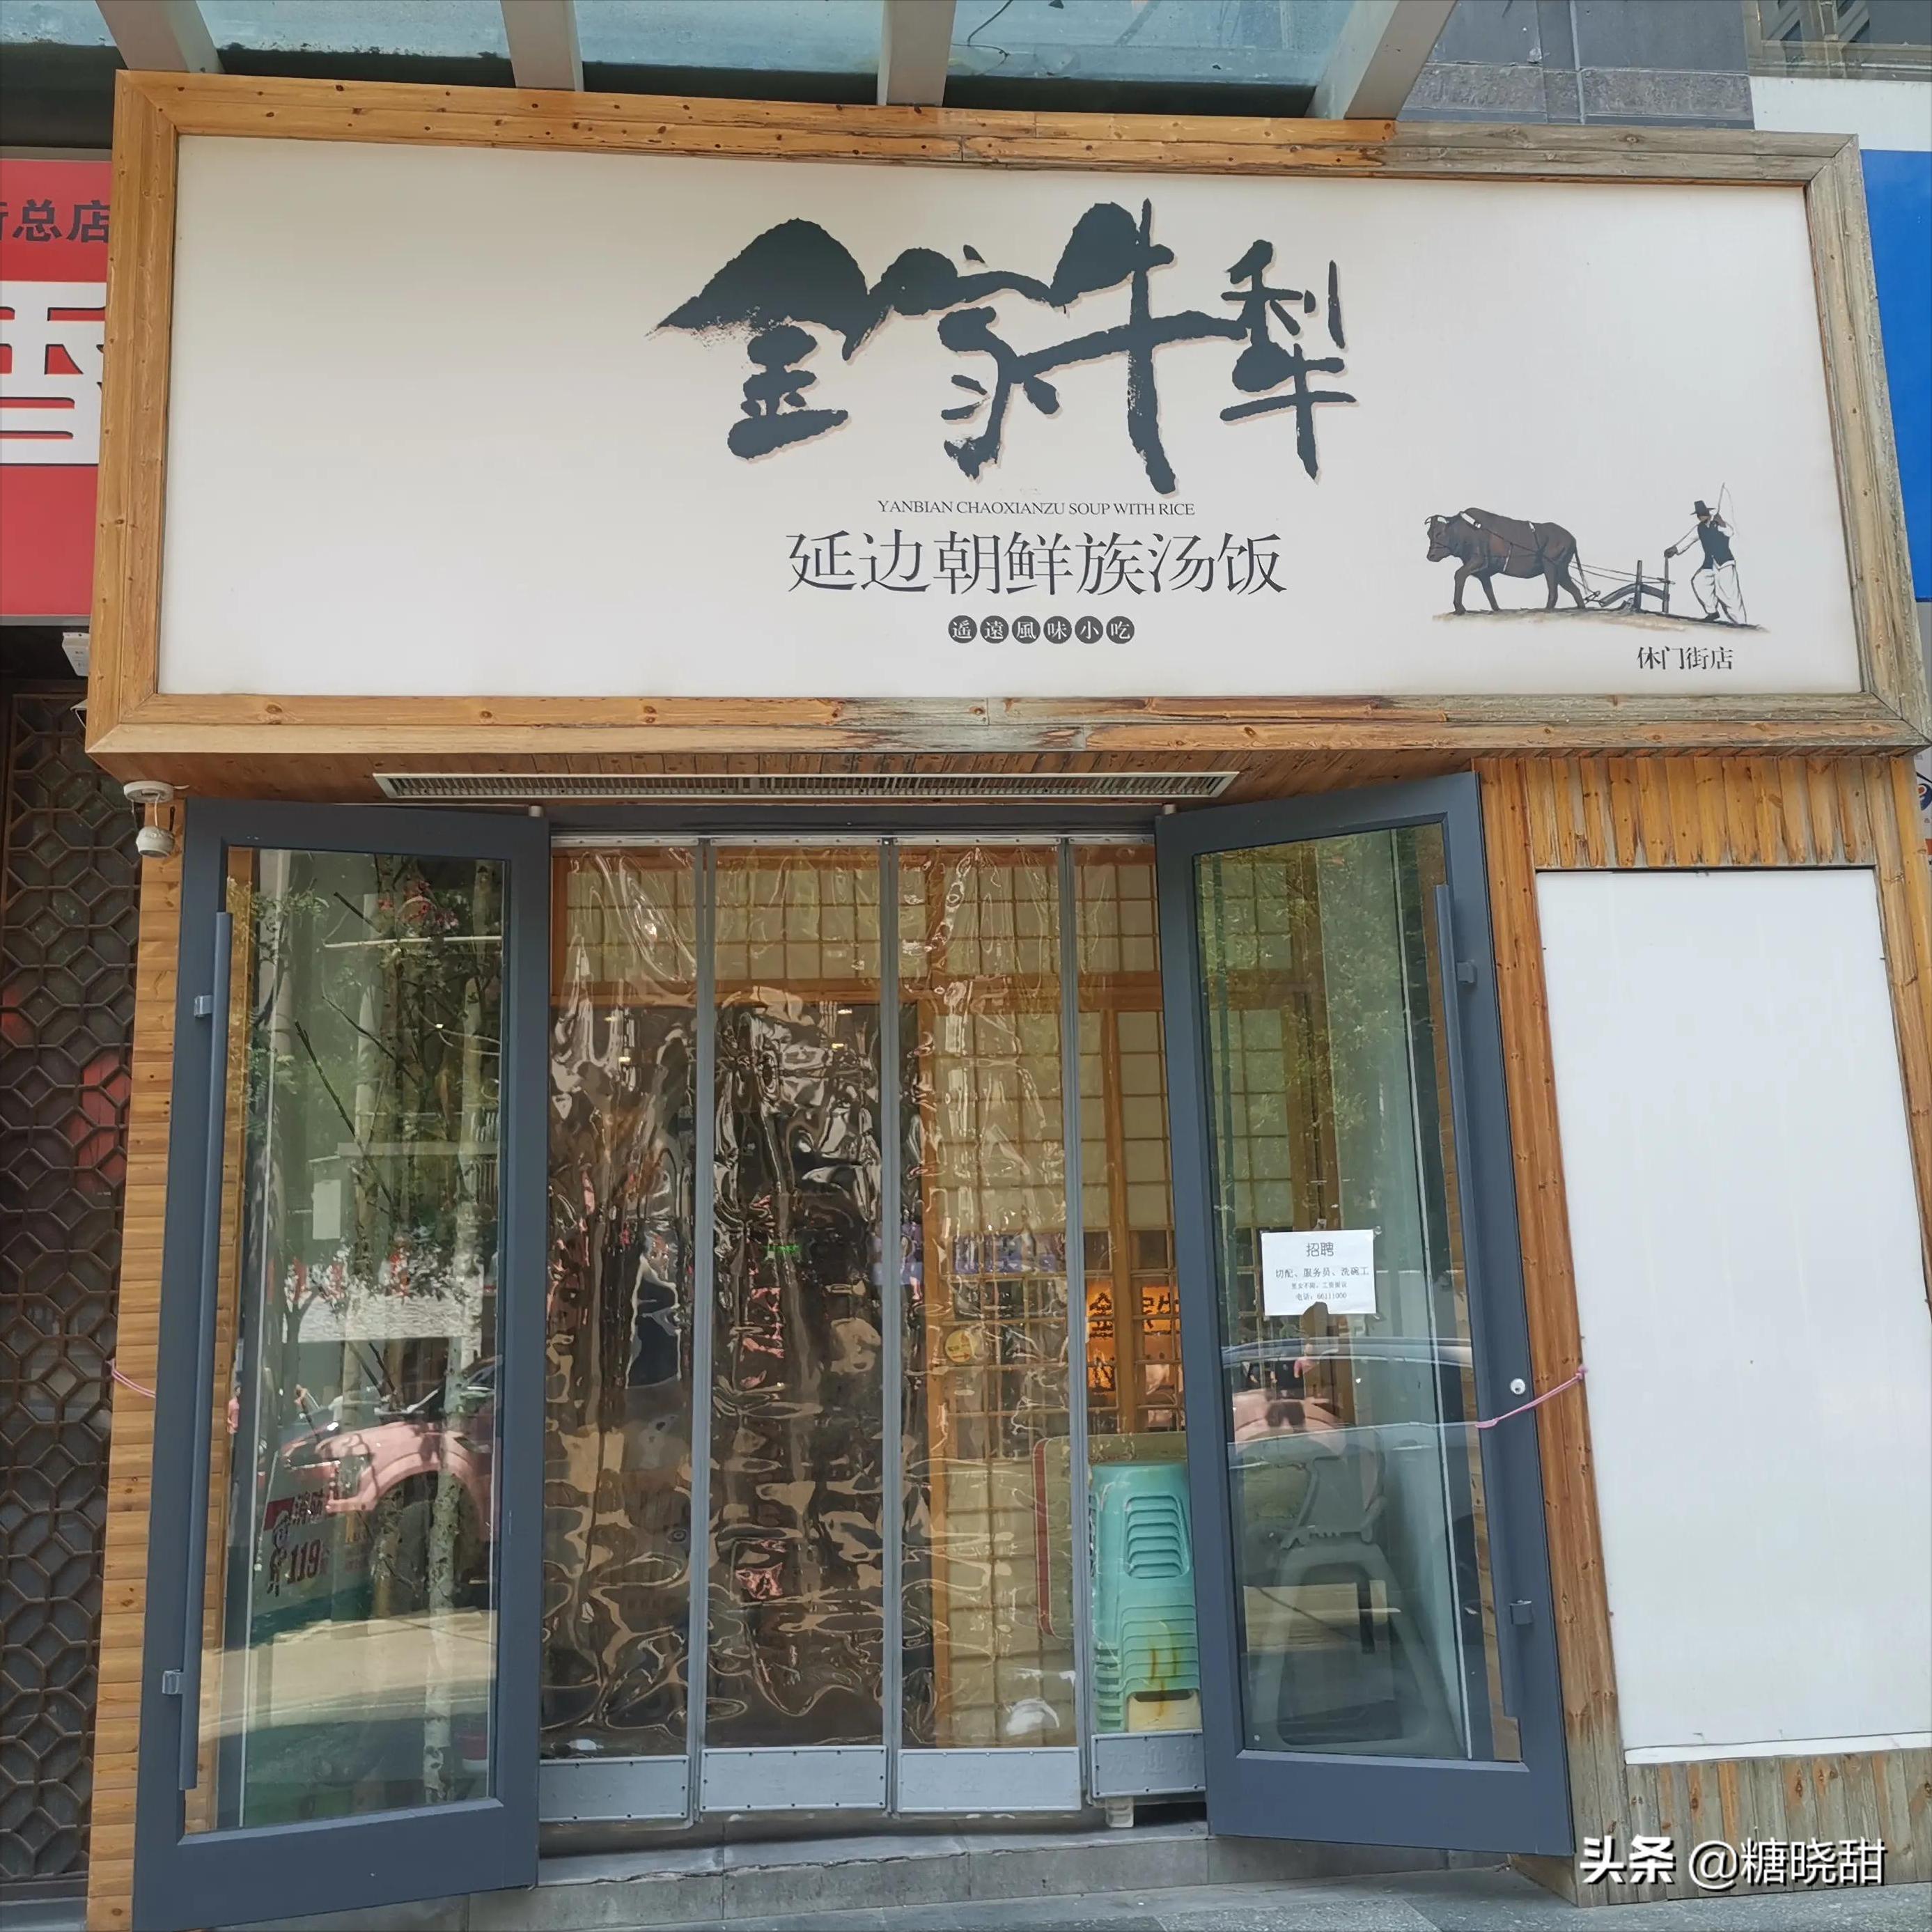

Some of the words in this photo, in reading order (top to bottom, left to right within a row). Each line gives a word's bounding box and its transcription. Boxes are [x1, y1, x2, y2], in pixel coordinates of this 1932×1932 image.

[878, 500, 953, 514] YANBIAN
[956, 501, 1066, 515] CHAOXIANZU
[1068, 502, 1110, 515] SOUP
[1113, 503, 1155, 515] WITH
[1158, 503, 1196, 515] RICE
[786, 529, 1288, 595] 延边朝鲜族汤饭
[1637, 646, 1734, 670] 休门街店
[1306, 1242, 1334, 1257] 招聘
